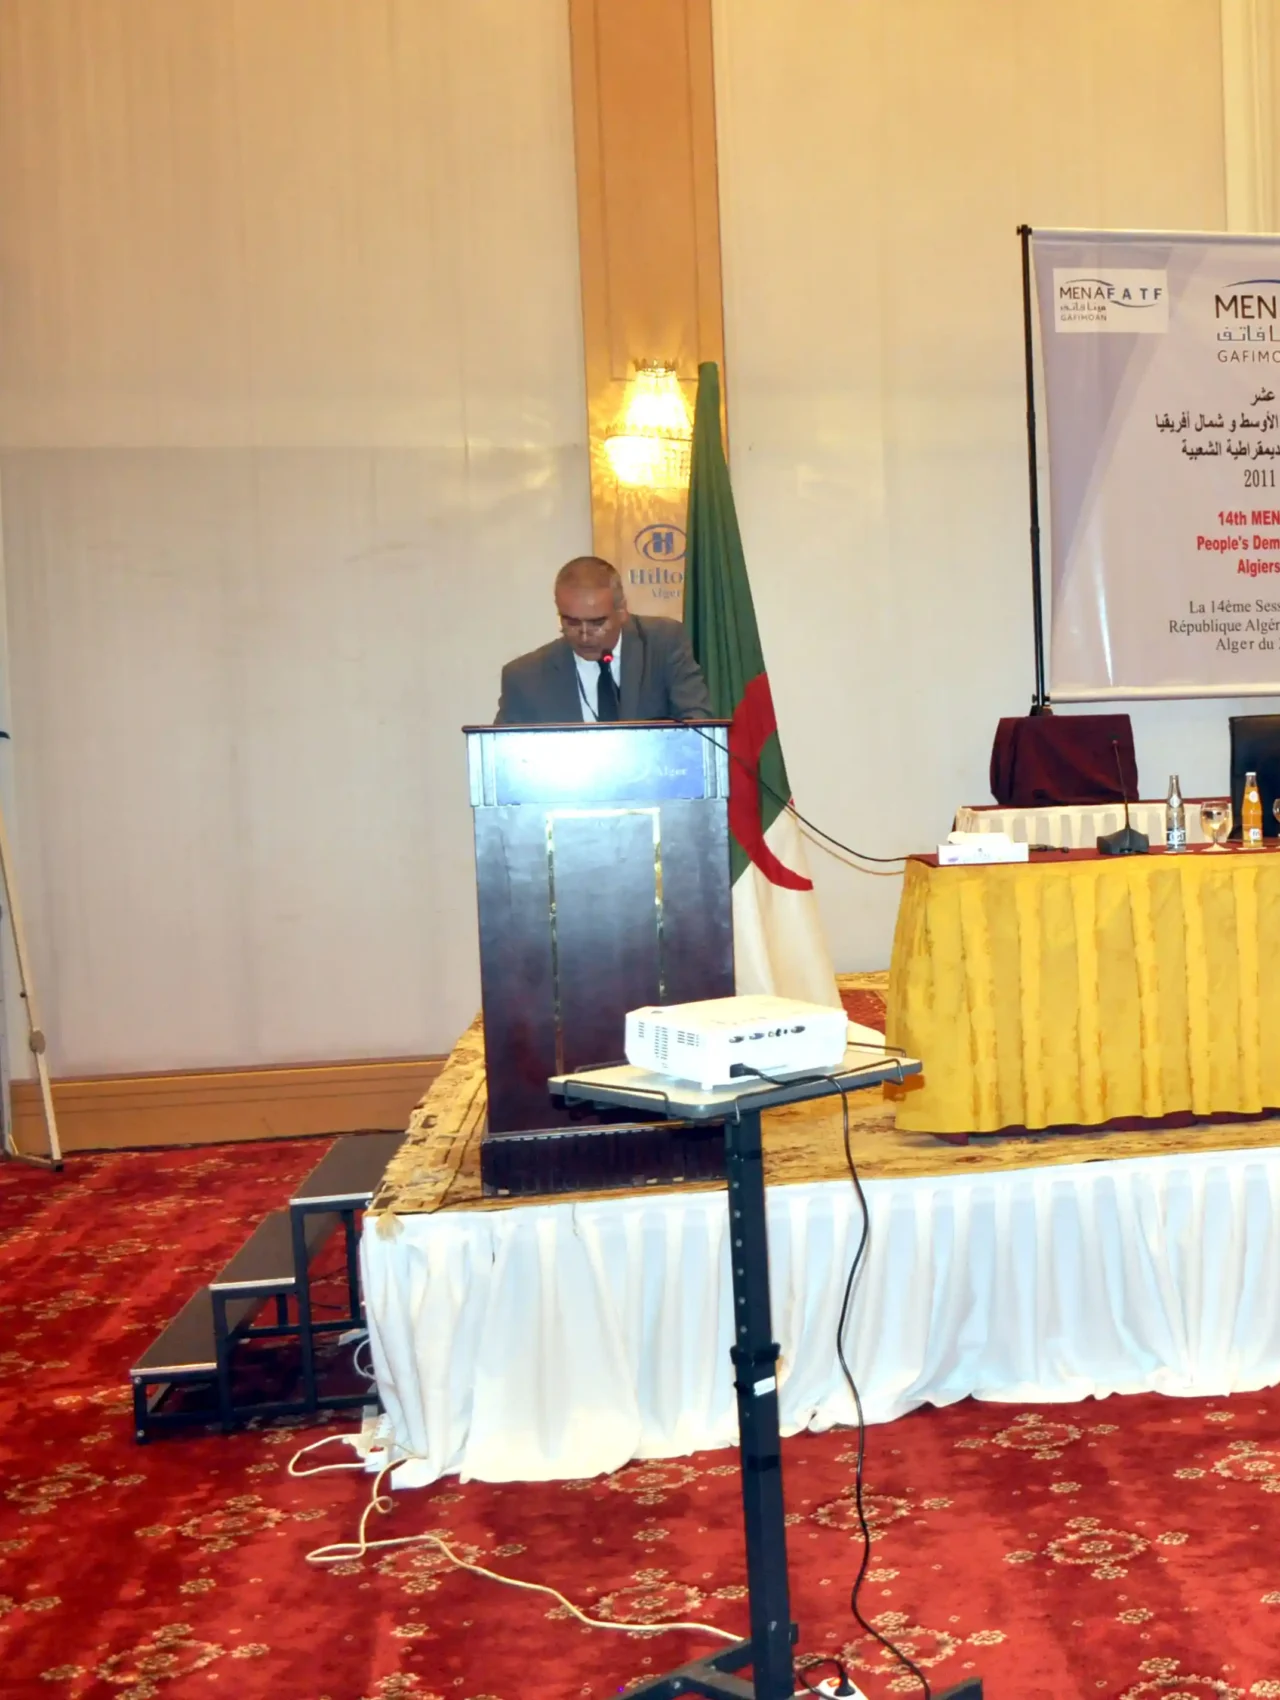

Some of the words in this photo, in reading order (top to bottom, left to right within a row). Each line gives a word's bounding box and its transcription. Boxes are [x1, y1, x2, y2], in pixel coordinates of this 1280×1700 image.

[1060, 313, 1107, 322] GAFIMOAN
[1250, 387, 1275, 406] عشر
[1195, 413, 1224, 432] شمال
[1228, 419, 1236, 432] و
[1239, 411, 1278, 432] الأوسط
[1181, 439, 1222, 460] الشعبية
[1244, 469, 1275, 488] 2011
[1218, 511, 1247, 526] 14th
[1197, 535, 1249, 554] People's
[629, 567, 684, 585] Hilto
[1237, 559, 1280, 577] Algiers
[1189, 600, 1205, 614] La
[1169, 619, 1242, 636] République
[1216, 637, 1254, 653] Alger
[1258, 637, 1274, 650] du
